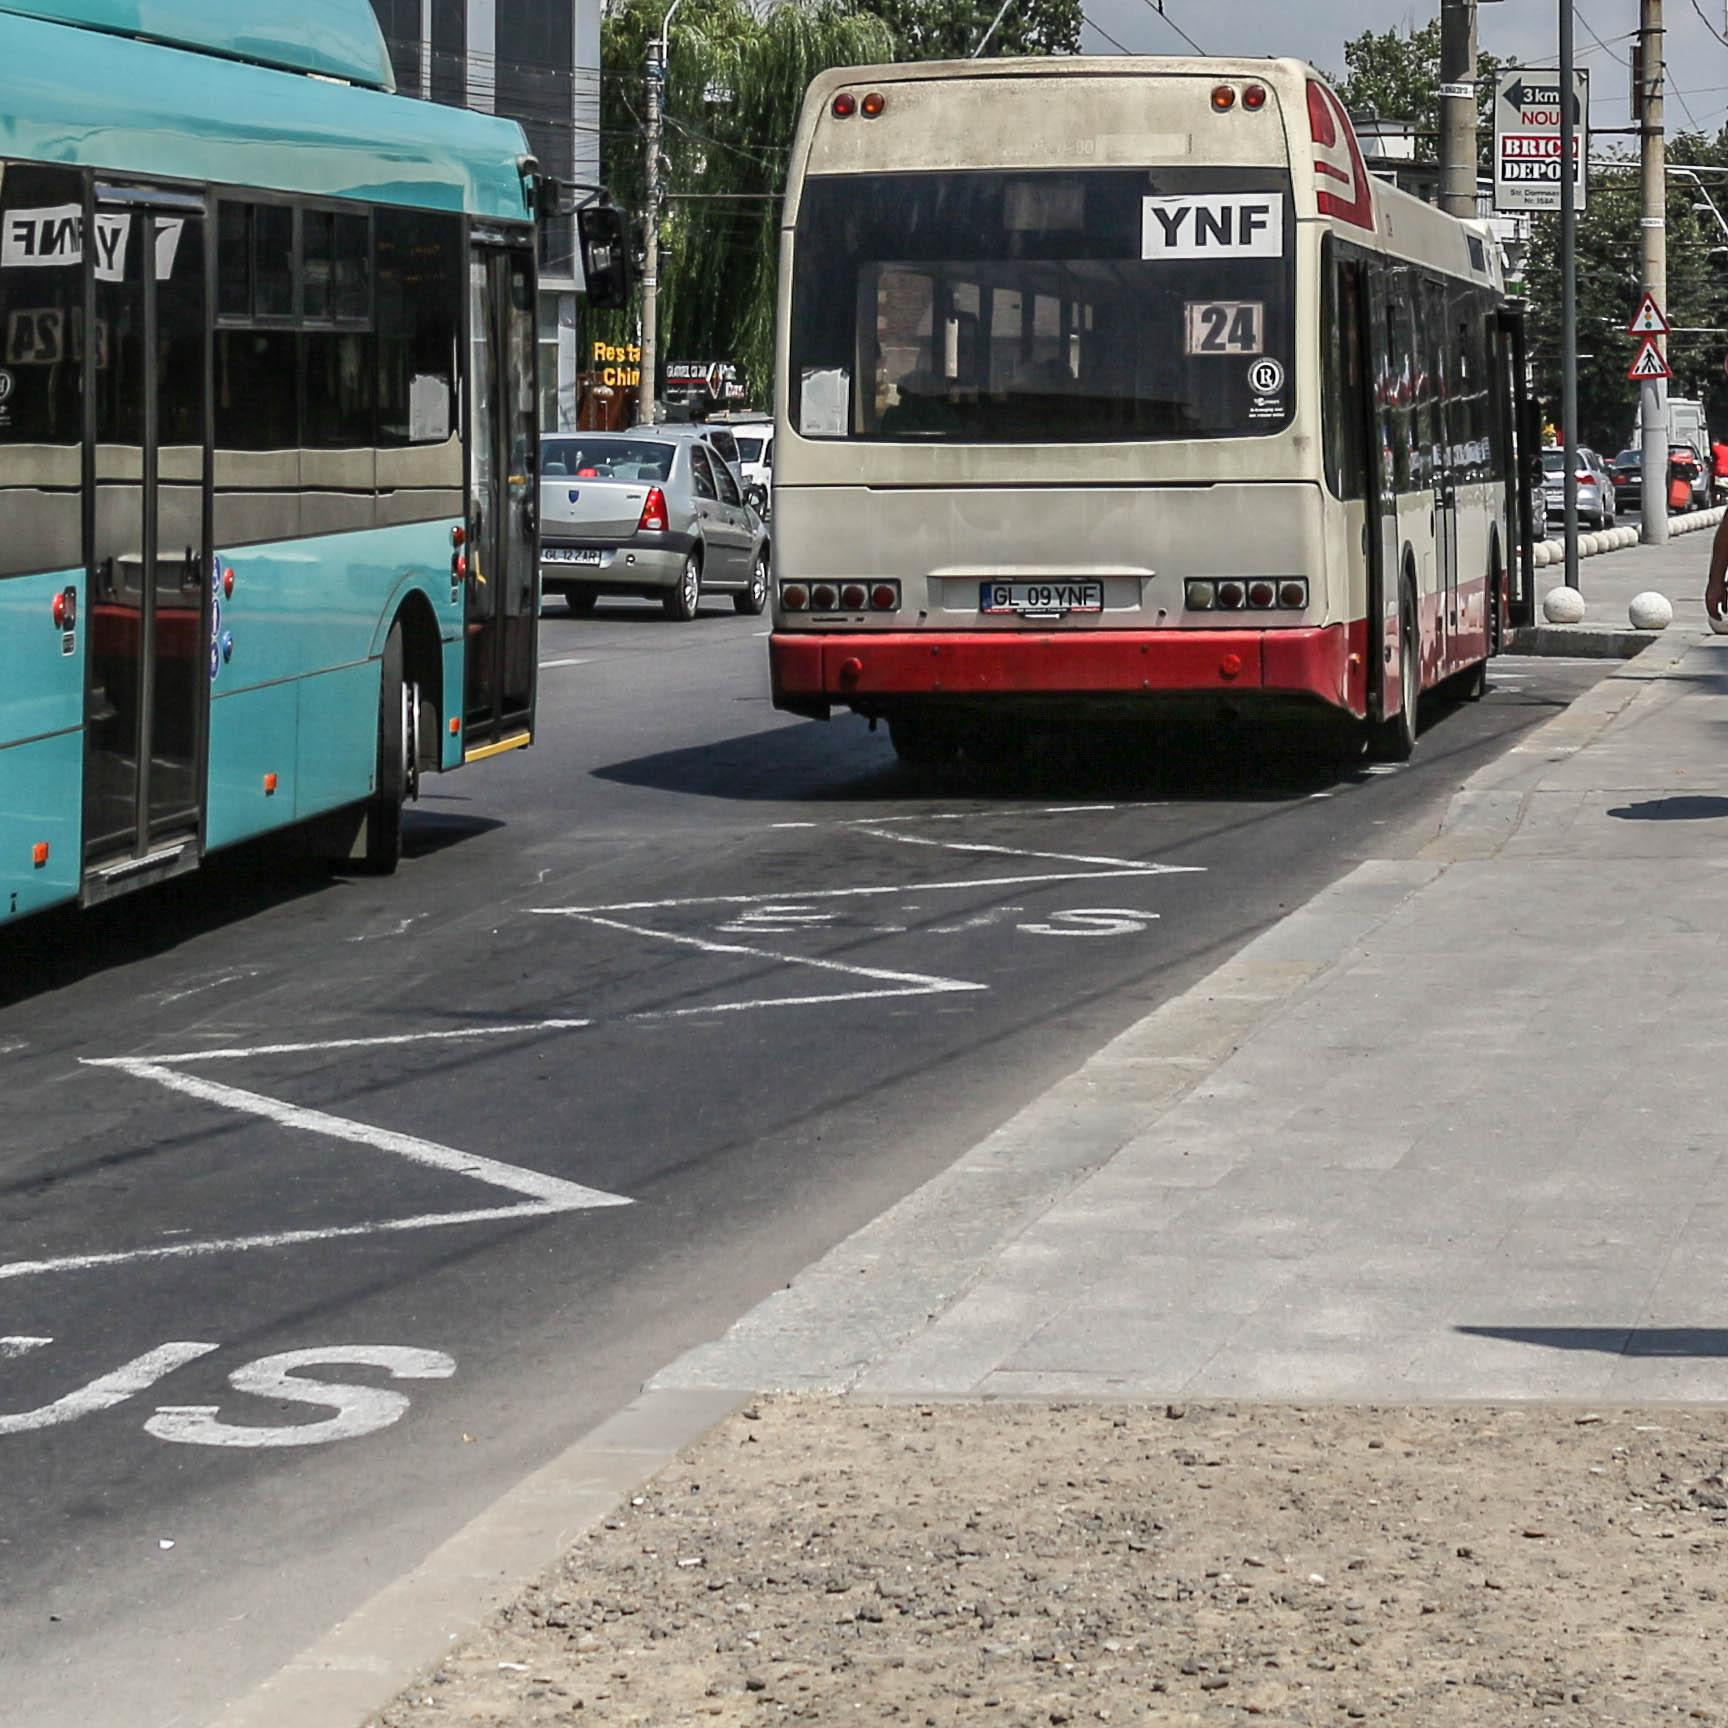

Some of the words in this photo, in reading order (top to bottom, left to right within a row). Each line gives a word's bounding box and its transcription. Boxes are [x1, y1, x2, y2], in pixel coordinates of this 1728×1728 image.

[1523, 88, 1533, 102] 3
[1535, 88, 1560, 103] km
[1521, 111, 1562, 125] NOU
[1503, 138, 1576, 155] BRIC
[1503, 156, 1576, 180] DEPÔ
[1151, 205, 1270, 247] YNF
[1200, 305, 1256, 351] 24
[993, 586, 1019, 607] GL
[1027, 586, 1052, 607] 09
[1055, 586, 1098, 607] YNF
